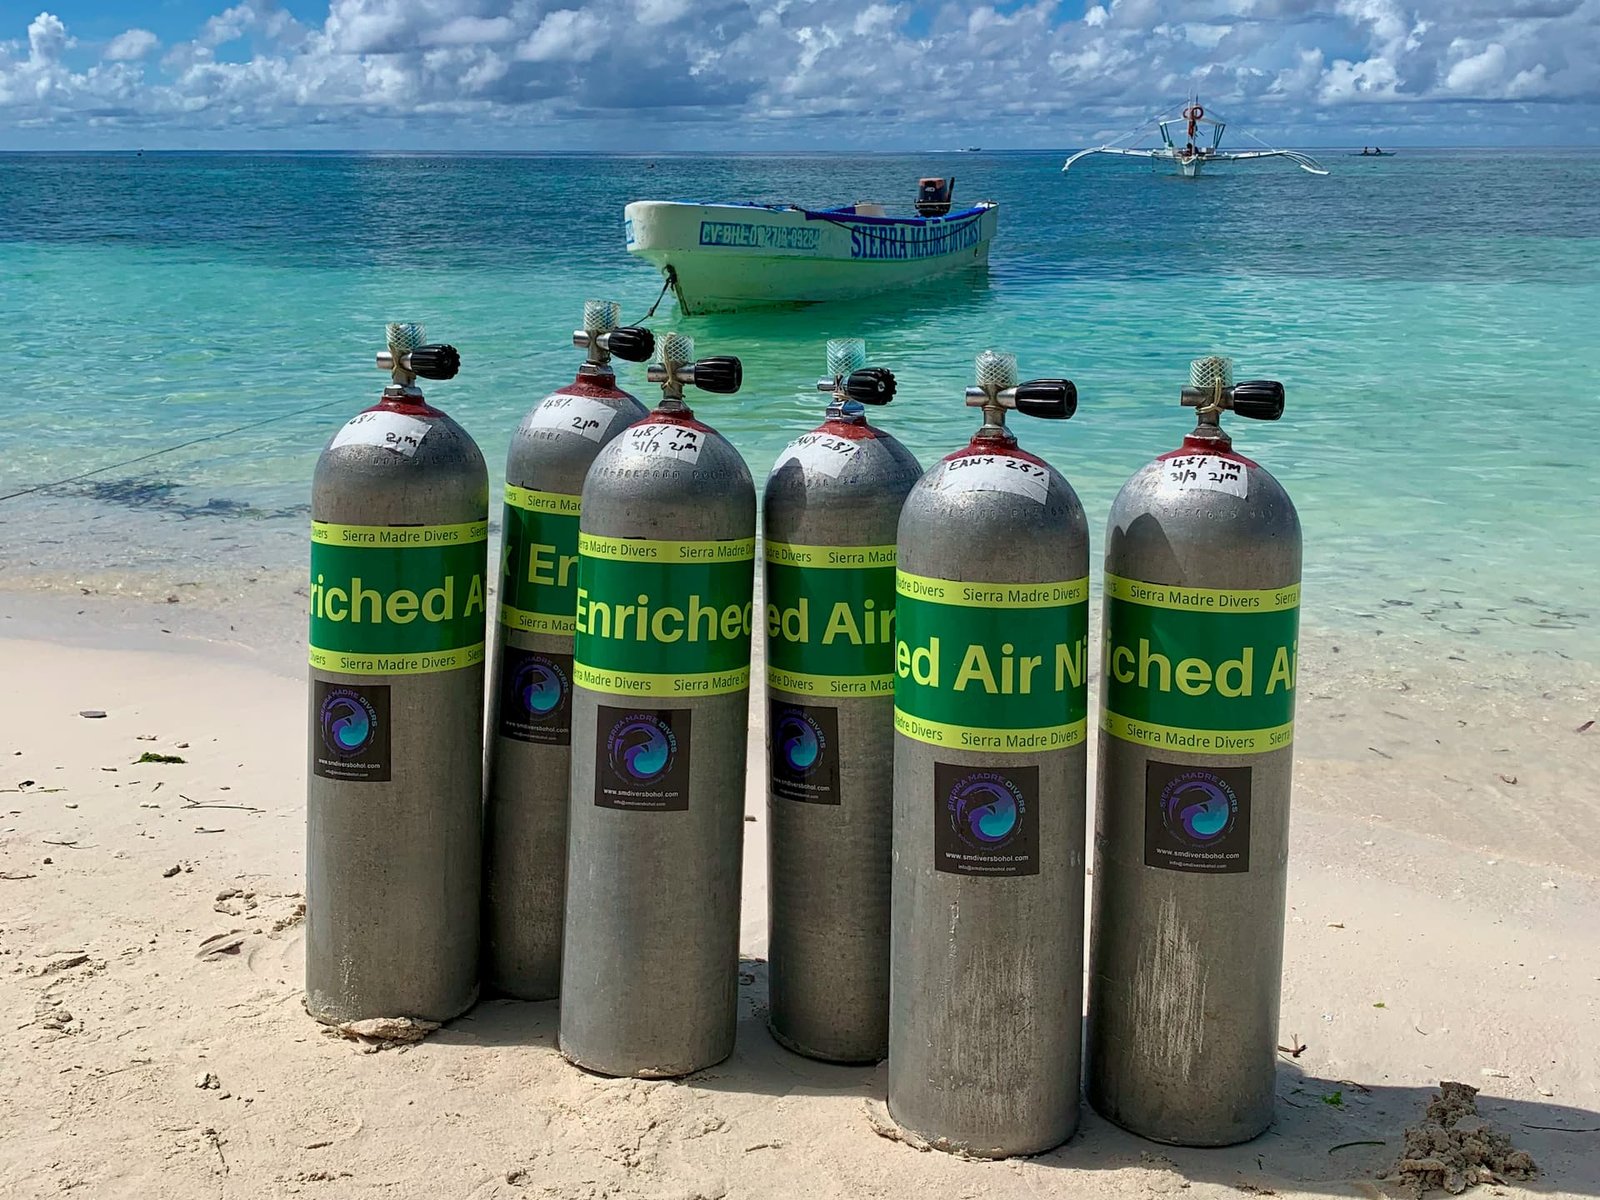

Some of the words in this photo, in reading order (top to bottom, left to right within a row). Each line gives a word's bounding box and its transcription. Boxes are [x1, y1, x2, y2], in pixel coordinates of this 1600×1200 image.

[851, 225, 907, 258] SIERRA
[910, 226, 948, 258] MADRE
[821, 438, 854, 457] 28%
[1219, 461, 1241, 474] TM
[528, 495, 556, 509] Sierra
[342, 530, 376, 543] Sierra
[379, 531, 420, 543] Madre
[424, 529, 459, 542] Divers
[590, 540, 617, 554] Madre
[620, 544, 657, 558] Divers
[679, 546, 714, 559] Sierra
[717, 544, 745, 557] Madre
[781, 549, 812, 563] Divers
[828, 552, 865, 564] Sierra
[463, 573, 486, 618] A
[913, 580, 945, 598] Divers
[963, 588, 1004, 602] Sierra
[1008, 589, 1050, 603] Madre
[1053, 587, 1081, 601] Divers
[1130, 585, 1165, 602] Sierra
[1169, 591, 1214, 607] Madre
[1219, 594, 1260, 608] Divers
[519, 615, 548, 629] Sierra
[821, 599, 896, 645] Air
[340, 657, 374, 670] Sierra
[377, 658, 418, 670] Madre
[421, 656, 456, 669] Divers
[897, 637, 940, 688] ed
[953, 643, 1042, 694] Air
[584, 671, 612, 687] Madre
[614, 676, 651, 691] Divers
[674, 679, 709, 691] Sierra
[712, 676, 740, 689] Madre
[783, 675, 814, 691] Divers
[830, 680, 867, 692] Sierra
[359, 696, 378, 727] DIVERS
[607, 720, 626, 750] SIERRA
[625, 714, 658, 724] MADRE
[659, 721, 678, 753] DIVERS
[808, 717, 827, 749] DIVERS
[911, 721, 943, 741] Divers
[961, 732, 1001, 747] Sierra
[1006, 733, 1048, 748] Madre
[1050, 729, 1078, 744] Divers
[1127, 723, 1162, 742] Sierra
[1165, 731, 1210, 748] Madre
[1214, 735, 1255, 749] Divers
[604, 788, 679, 798] www.smdiversbohol.com
[947, 779, 968, 812] SIERRA
[967, 772, 1005, 783] MADRE
[1005, 780, 1026, 814] DIVERS
[1160, 777, 1182, 809] SIERRA
[1182, 771, 1218, 783] MADRE
[1218, 779, 1239, 813] DIVERS
[945, 851, 1029, 862] www.smdiversbohol.com
[1156, 848, 1240, 860] www.smdiversbohol.com
